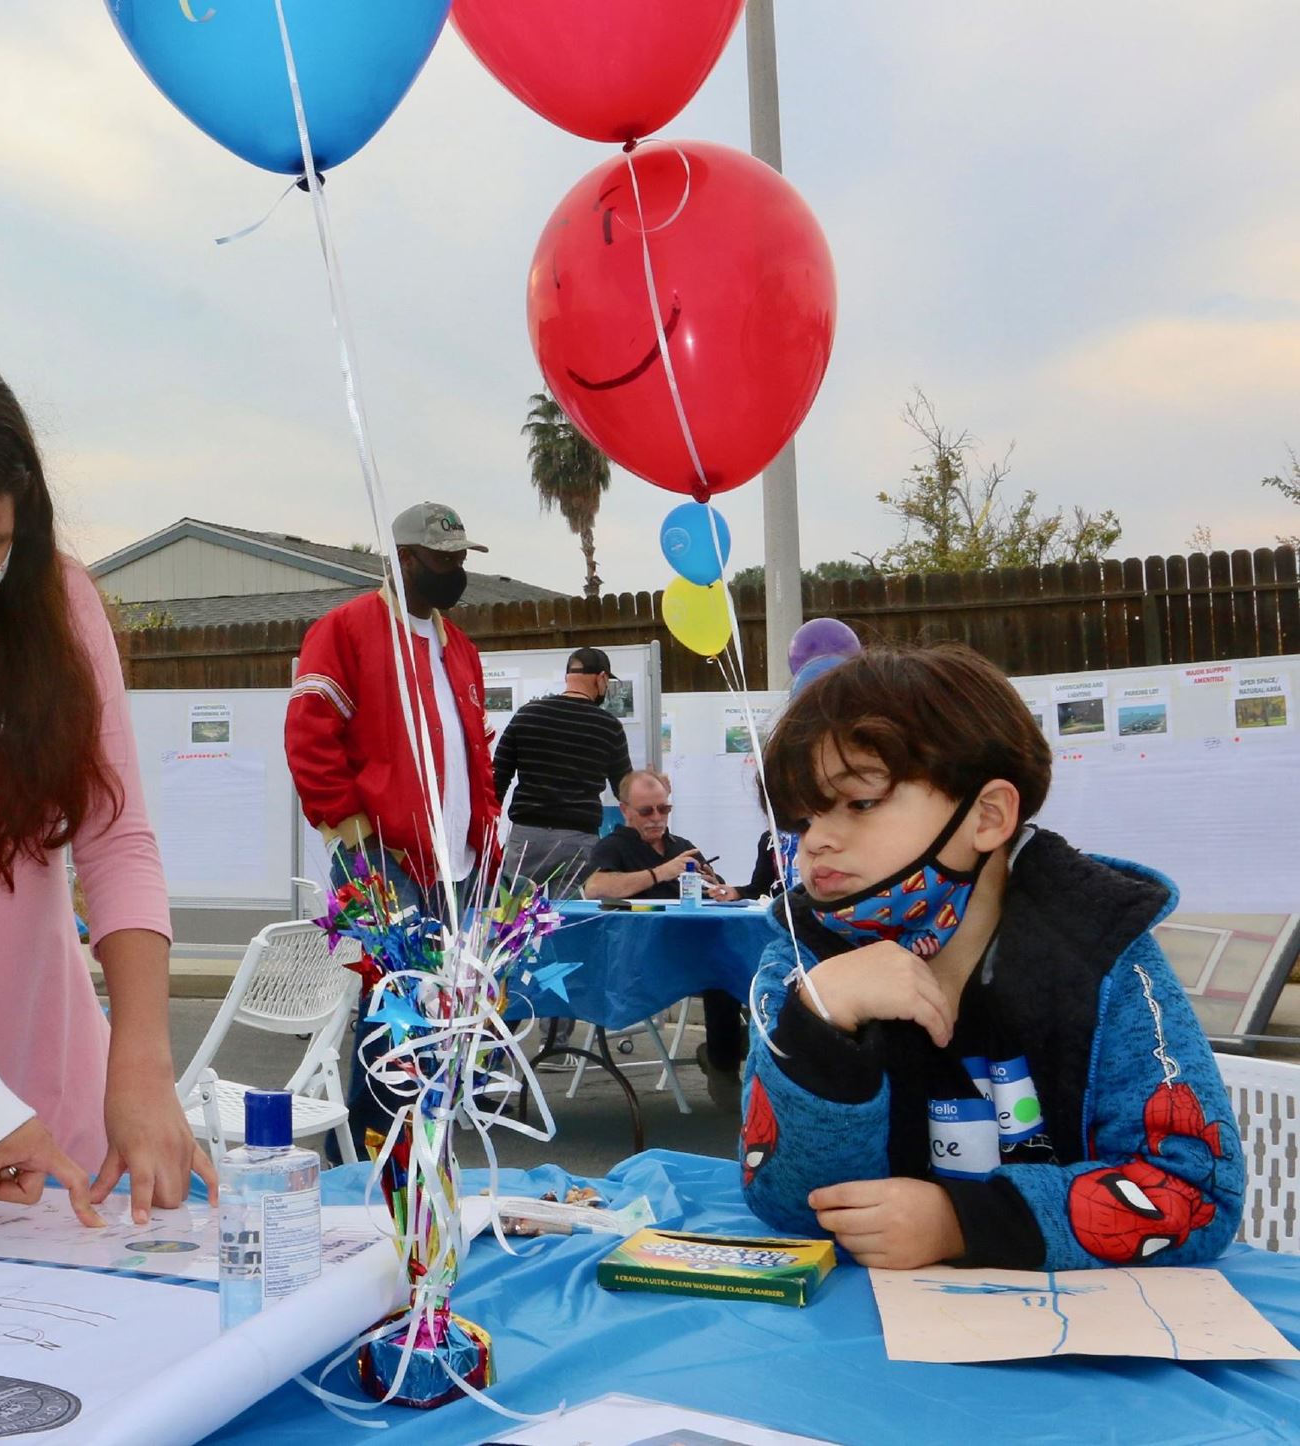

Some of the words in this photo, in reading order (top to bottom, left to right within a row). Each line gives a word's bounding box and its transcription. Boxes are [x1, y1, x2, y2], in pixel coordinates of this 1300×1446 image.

[619, 1274, 649, 1285] CRAYOLA
[649, 1277, 692, 1290] ULTRA-CLEAN
[692, 1282, 726, 1292] WASHABLE
[726, 1285, 753, 1295] CLASSIC
[753, 1288, 785, 1298] MARKERS
